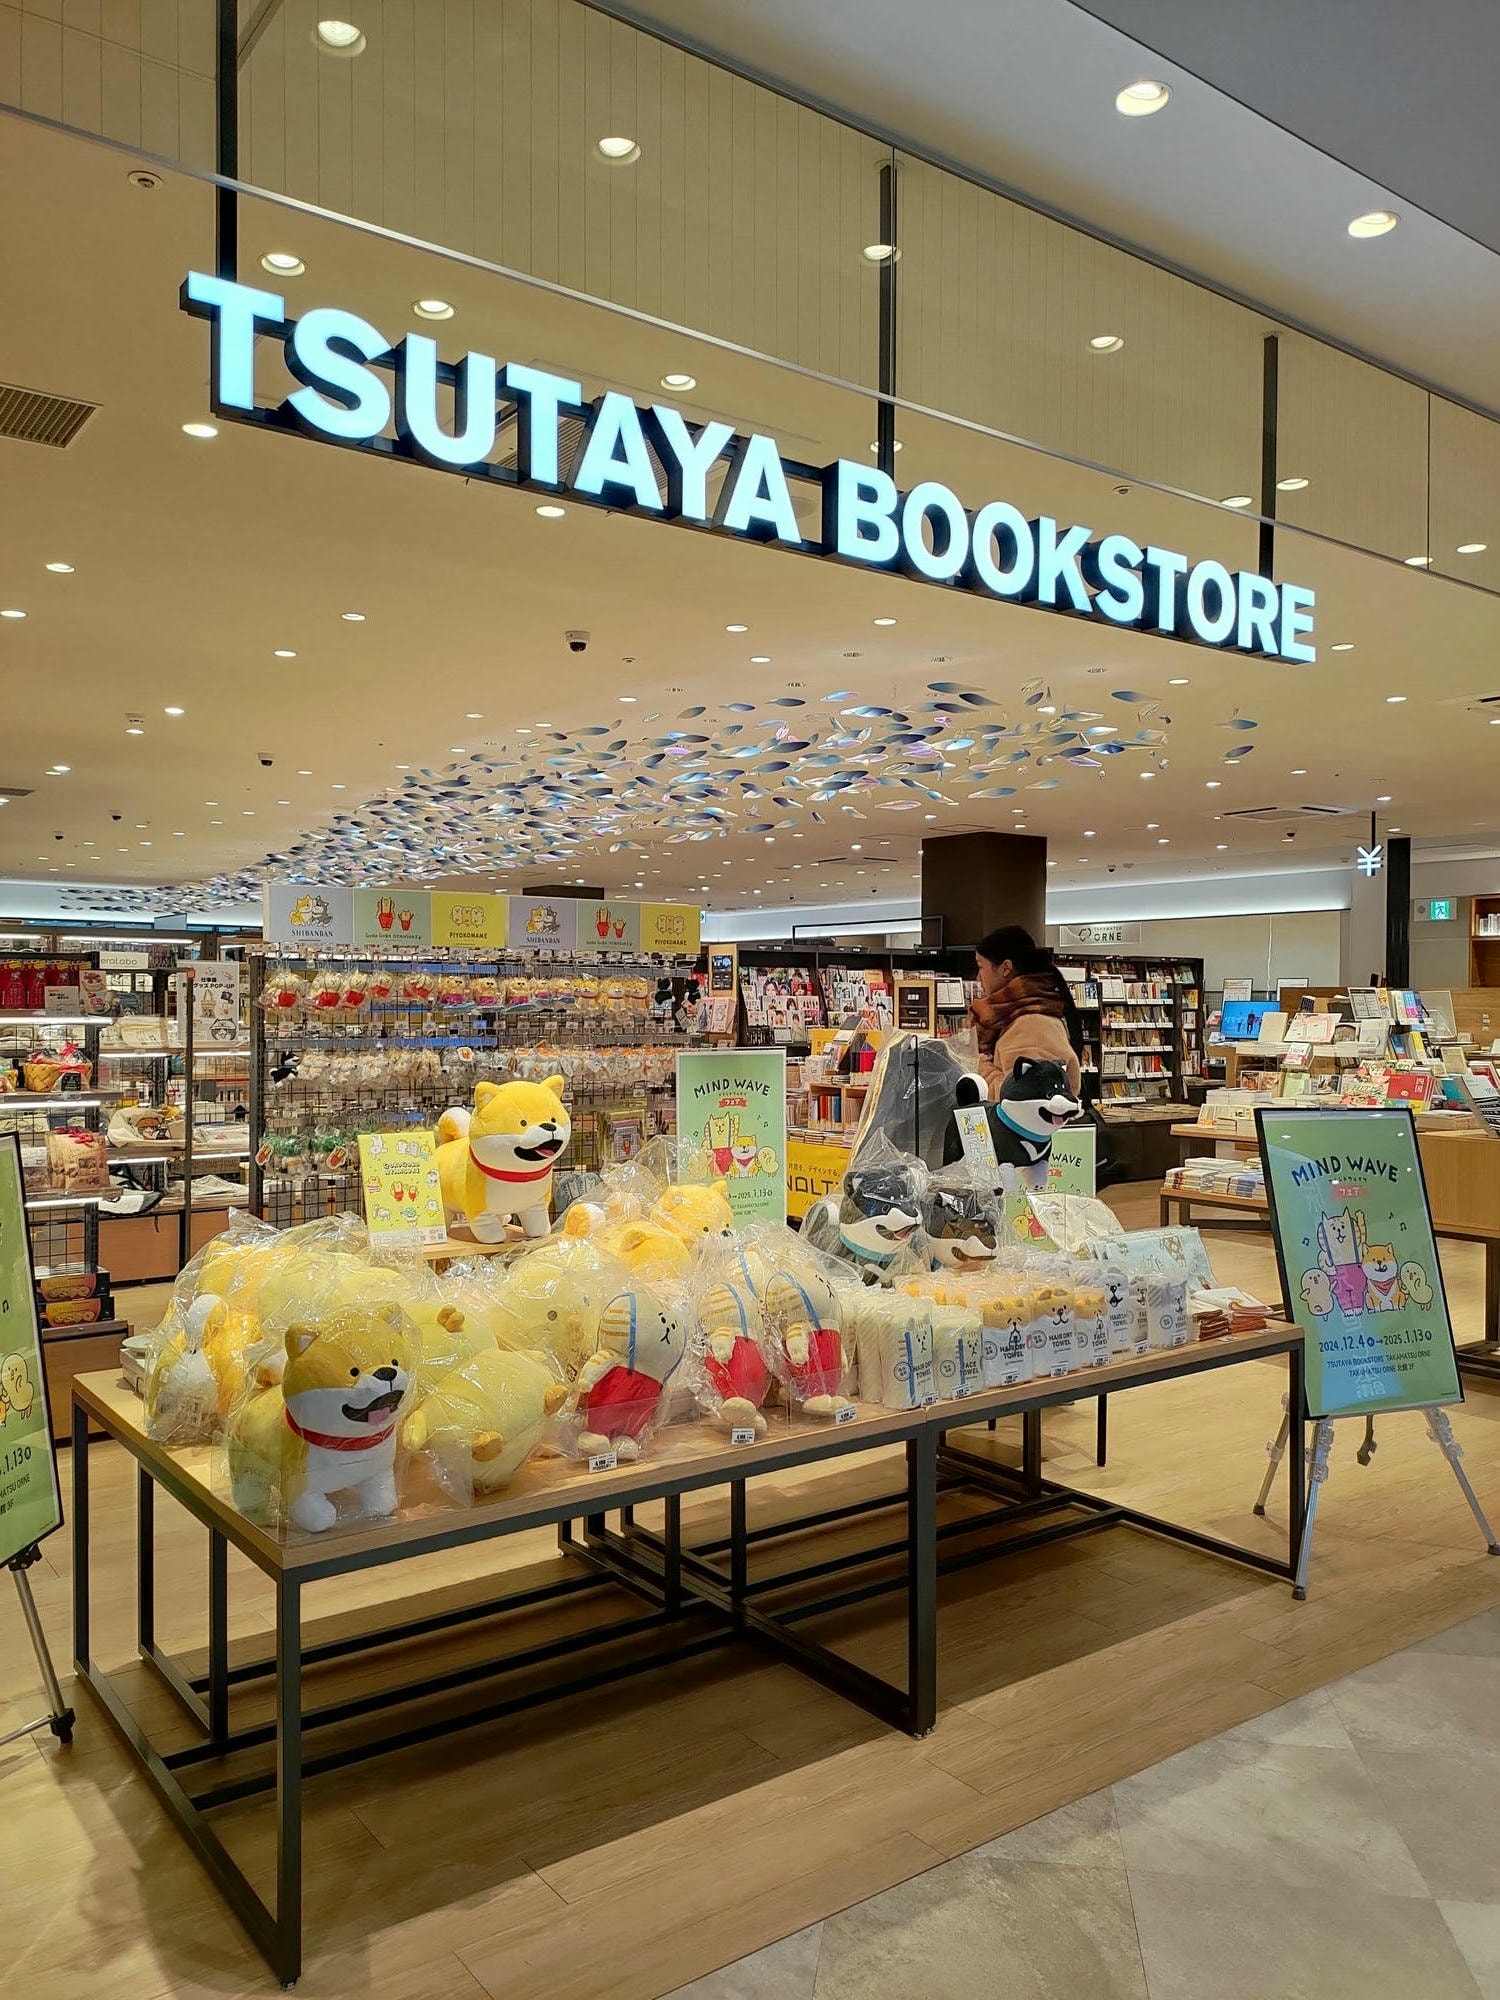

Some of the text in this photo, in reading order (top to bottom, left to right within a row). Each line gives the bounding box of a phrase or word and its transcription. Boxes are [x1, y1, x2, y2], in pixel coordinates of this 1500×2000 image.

[187, 270, 1317, 662] TSUTAYA BOOKSTORE
[1094, 932, 1122, 941] ORNE
[693, 1078, 770, 1099] MIND WAVE
[1052, 1153, 1082, 1167] WAVE
[1291, 1155, 1399, 1187] MIND WAVE
[1339, 1187, 1361, 1196] フェア
[1052, 1338, 1072, 1347] TOWEL
[1000, 1343, 1026, 1353] HAIR DRY
[1003, 1350, 1024, 1359] TOWEL
[1327, 1350, 1432, 1369] TSUTAYA BOOKSTORE TAKAMATSU ORNE
[916, 1369, 932, 1379] TOWEL
